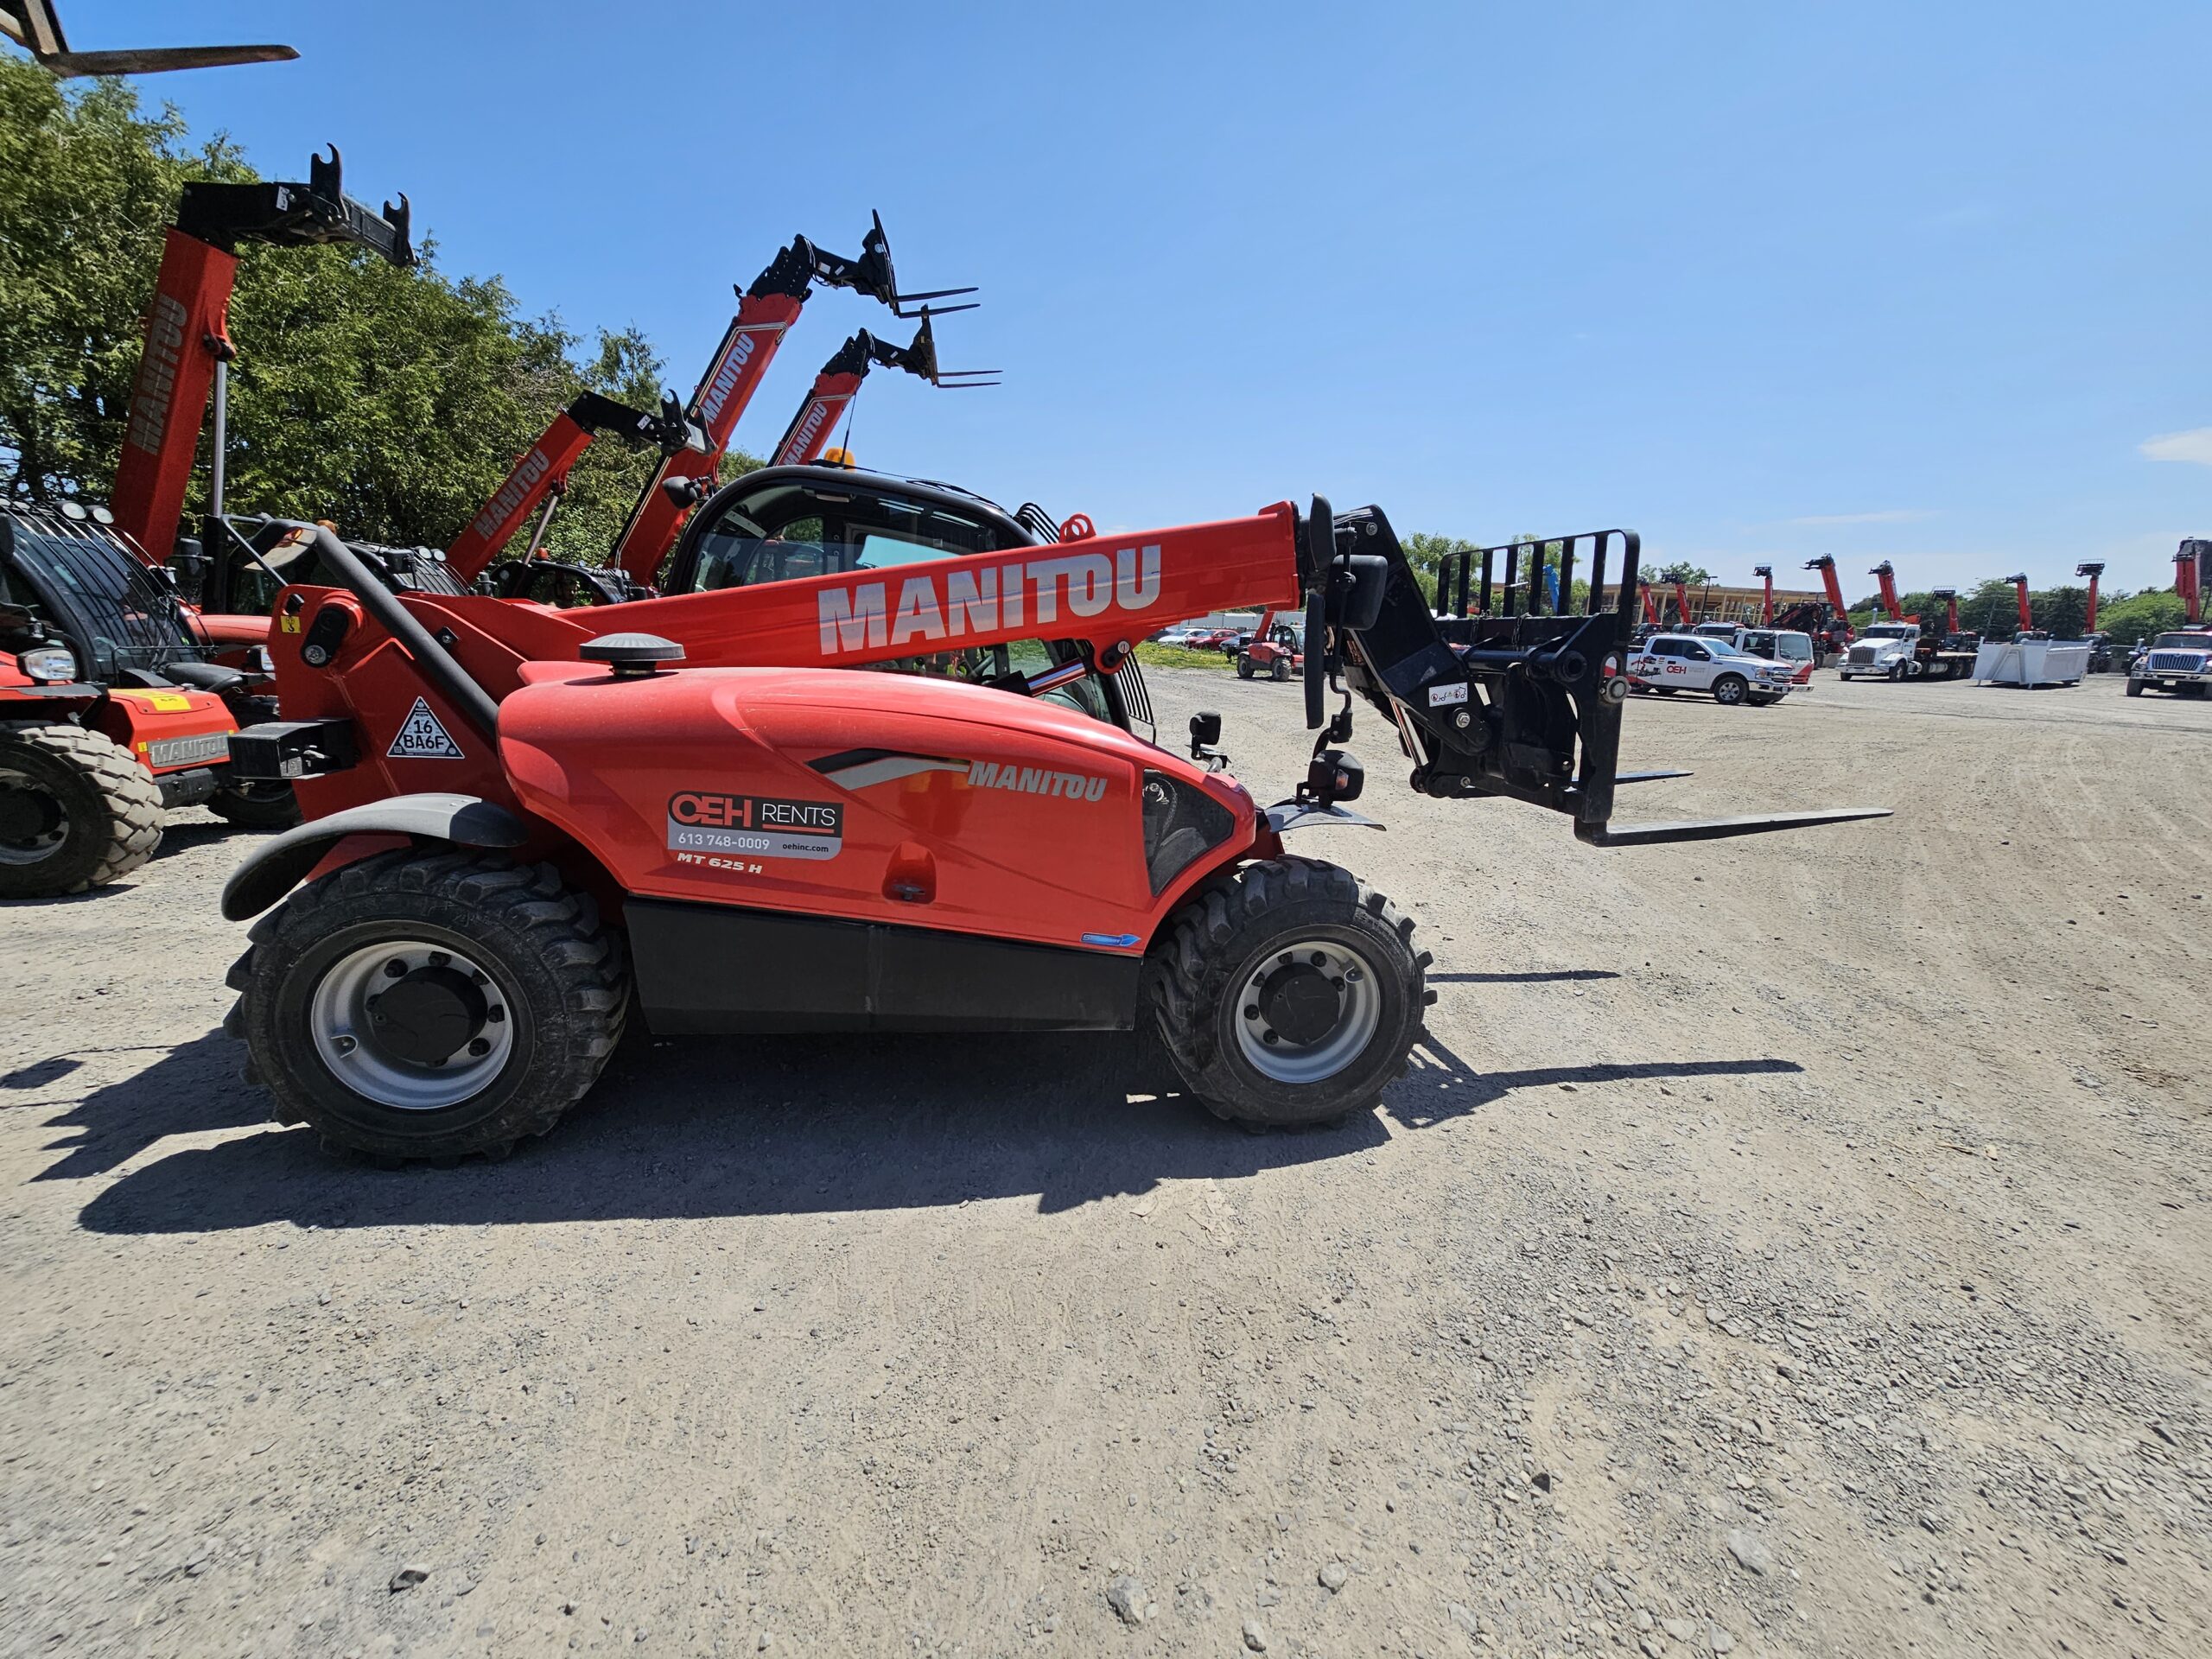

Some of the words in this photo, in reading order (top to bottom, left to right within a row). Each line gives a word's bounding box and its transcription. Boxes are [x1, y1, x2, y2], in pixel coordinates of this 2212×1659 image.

[130, 293, 188, 455] MANITOU
[702, 332, 755, 424] MANITOU
[474, 448, 550, 541] MANITOU
[817, 544, 1161, 656] MANITOU
[1666, 664, 1688, 674] OEH
[403, 734, 445, 749] BA6F
[413, 719, 433, 734] 16
[968, 760, 1108, 802] MANITOU
[671, 794, 753, 828] OEH
[761, 803, 836, 826] RENTS
[677, 832, 703, 845] 613
[706, 835, 770, 850] 748-0009
[782, 842, 829, 853] oehinc.com
[677, 852, 706, 864] MT
[708, 857, 745, 871] 625
[747, 864, 763, 874] H
